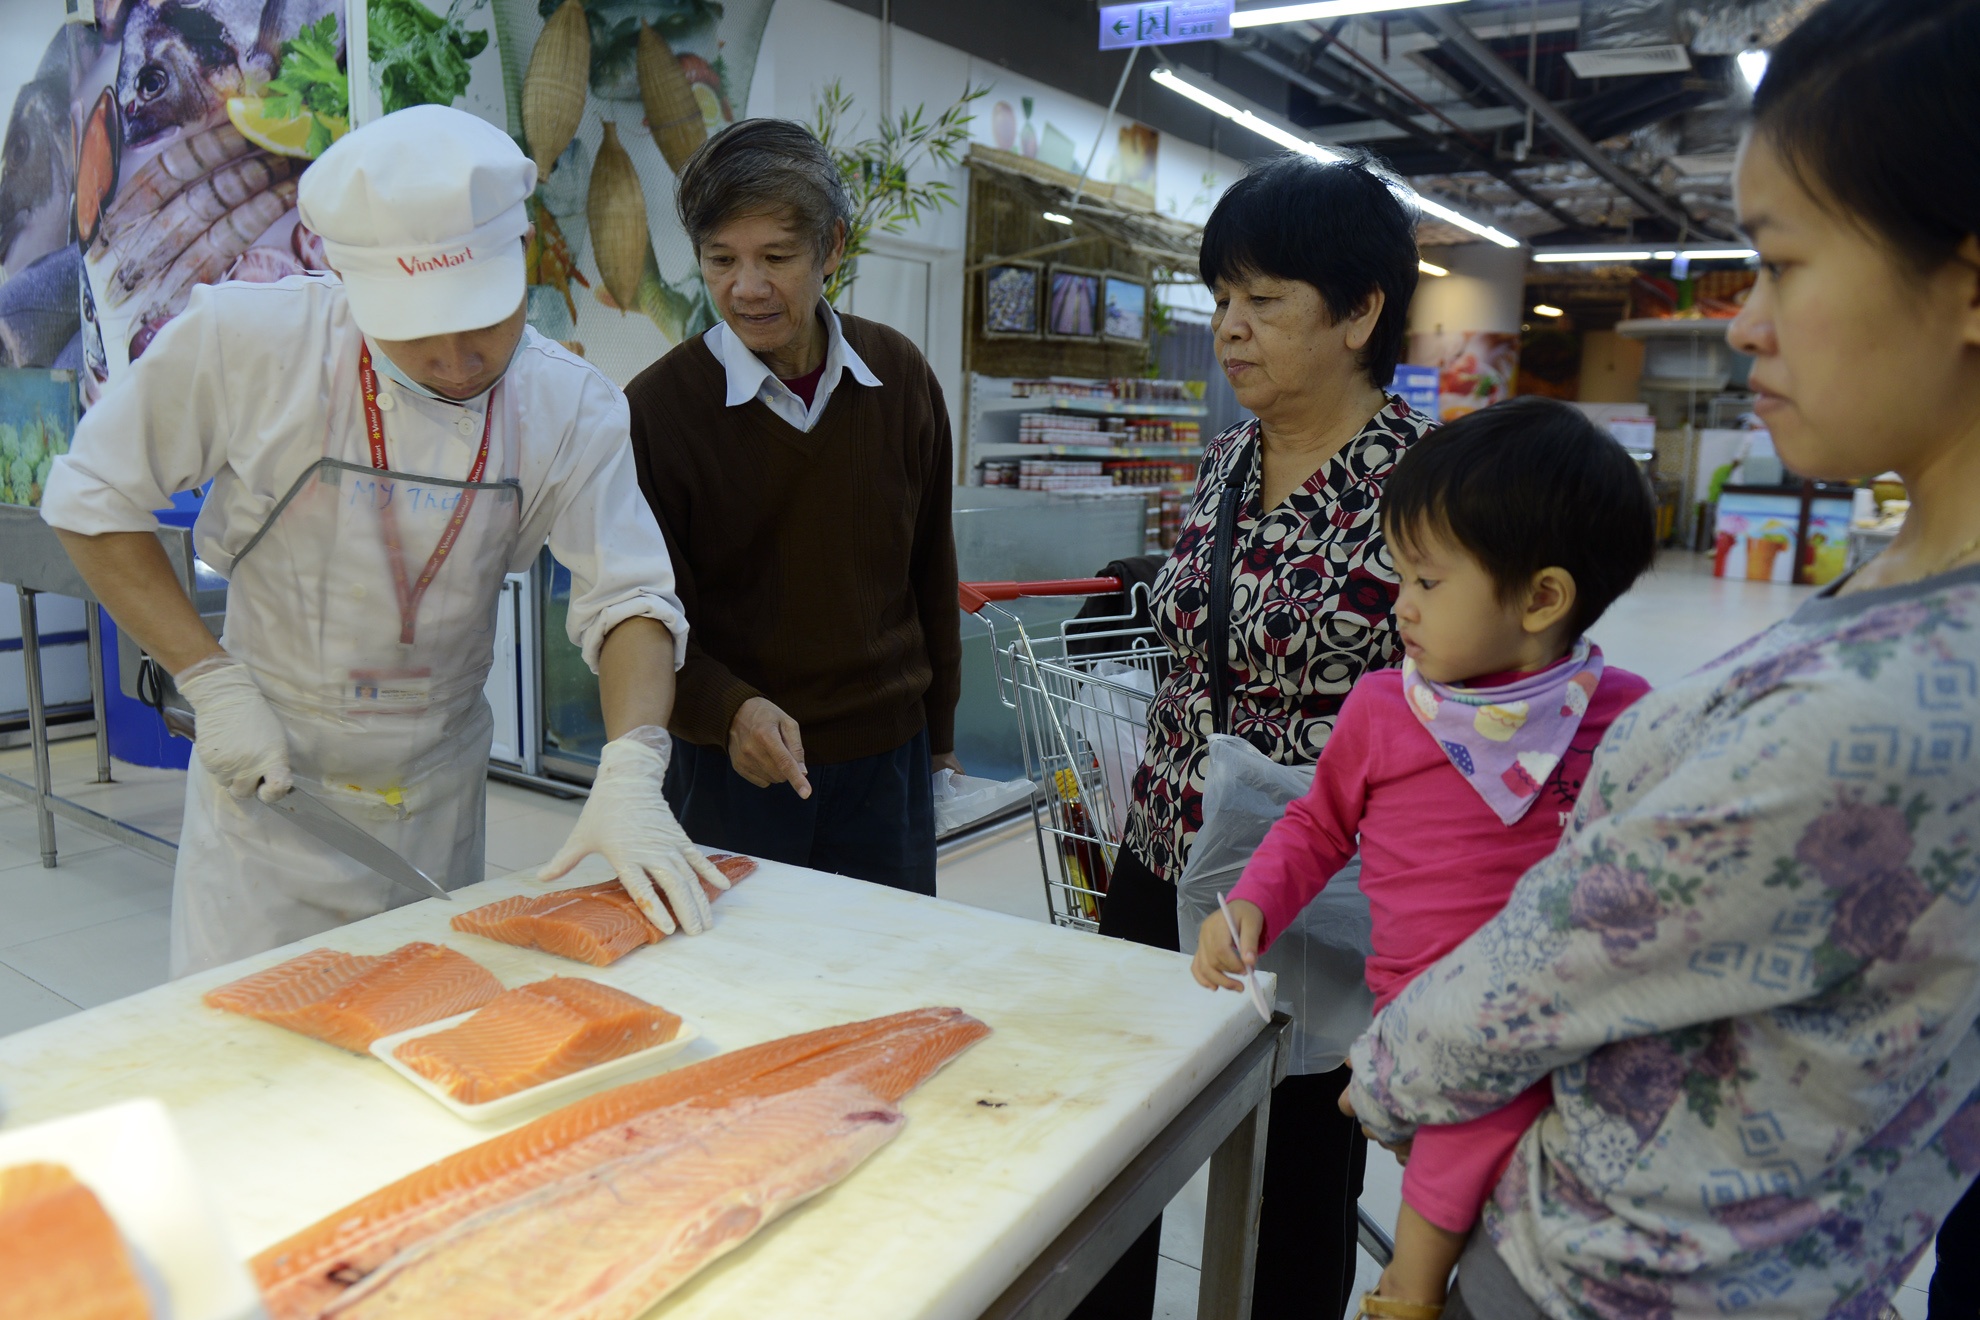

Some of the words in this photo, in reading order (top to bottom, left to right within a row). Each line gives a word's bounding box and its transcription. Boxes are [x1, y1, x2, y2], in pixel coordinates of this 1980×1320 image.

[1179, 22, 1215, 36] EXIT
[397, 246, 474, 277] VinMart
[365, 370, 374, 393] VinMart
